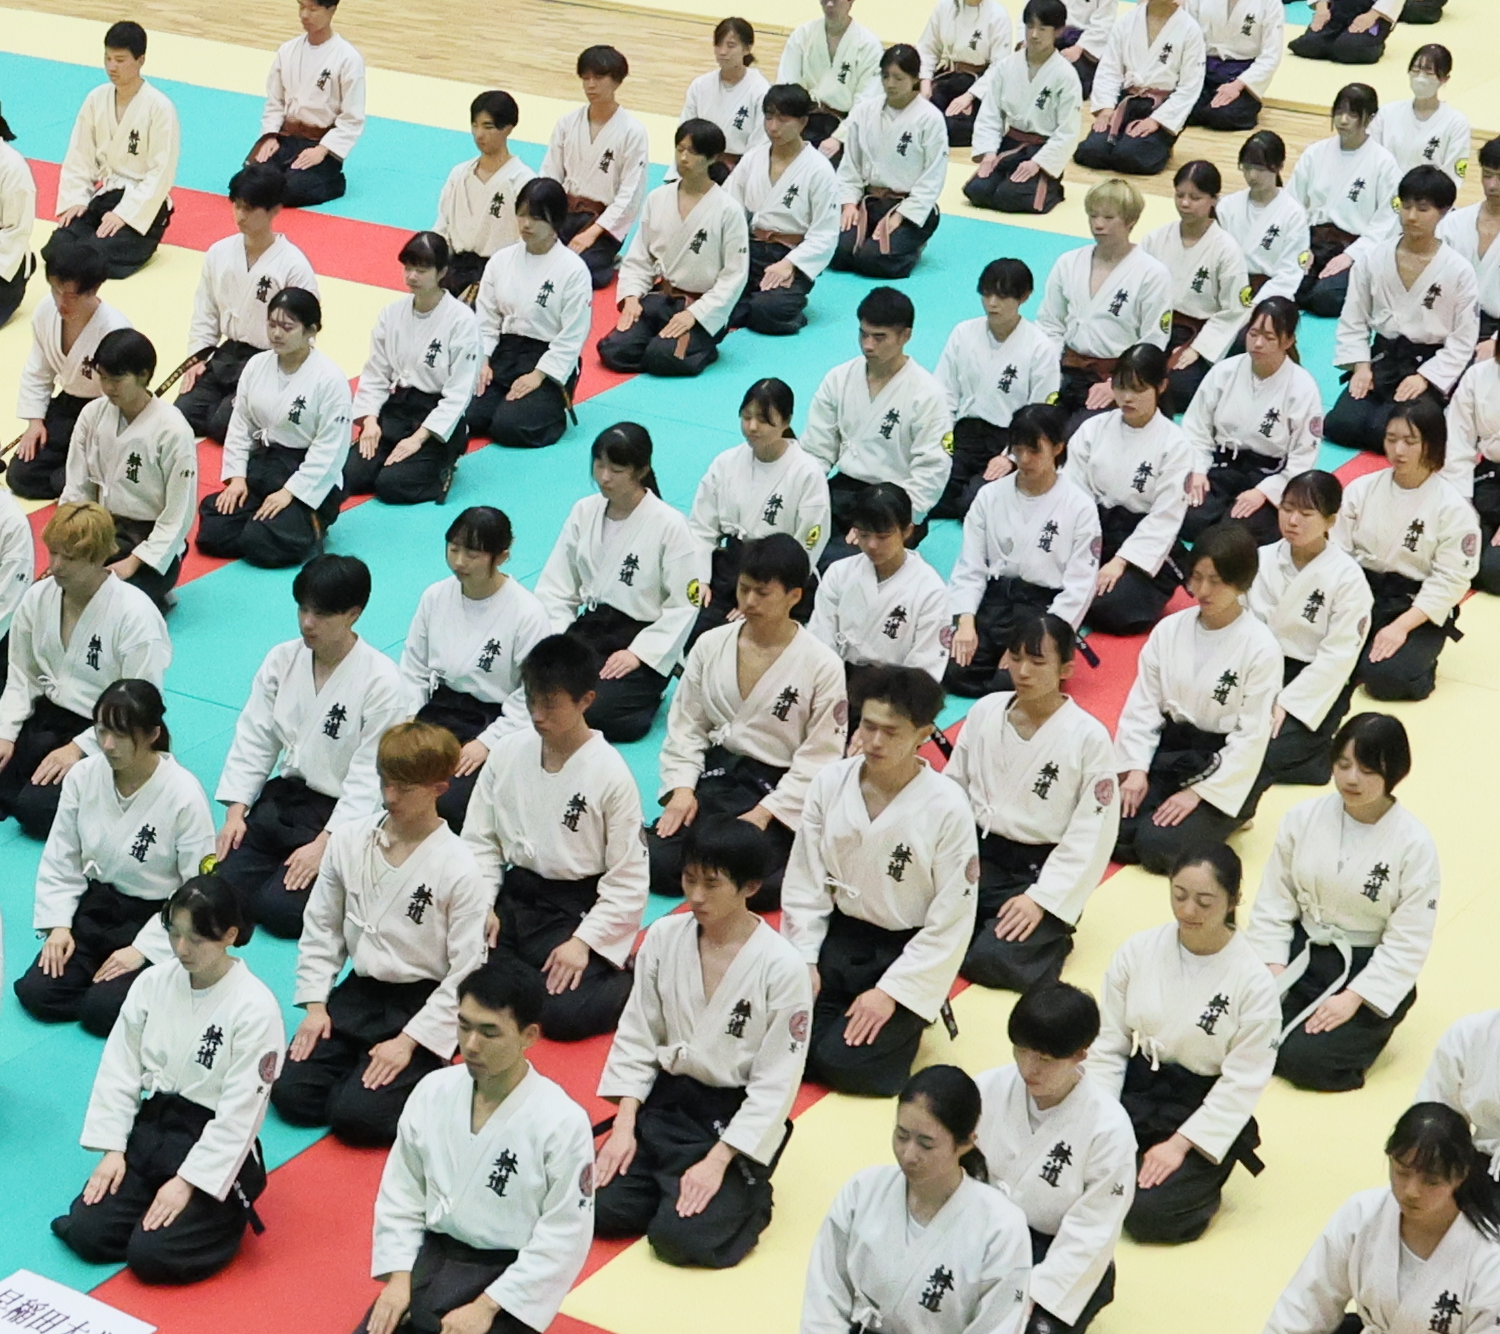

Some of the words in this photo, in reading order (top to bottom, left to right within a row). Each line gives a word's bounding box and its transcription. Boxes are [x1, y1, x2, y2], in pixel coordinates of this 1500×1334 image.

[86, 634, 102, 671] 躰道
[1212, 669, 1238, 706] 躰道
[323, 703, 347, 740] 躰道
[1032, 761, 1059, 800] 躰道
[562, 793, 587, 832] 躰道
[129, 824, 156, 863] 躰道
[887, 843, 912, 882] 躰道
[1361, 863, 1389, 902] 躰道
[405, 884, 437, 925] 躰道
[725, 999, 751, 1038] 躰道
[1196, 993, 1229, 1035] 躰道
[195, 1024, 223, 1070] 躰道
[486, 1149, 518, 1197] 躰道
[1039, 1141, 1072, 1187] 躰道
[918, 1265, 954, 1313] 躰道
